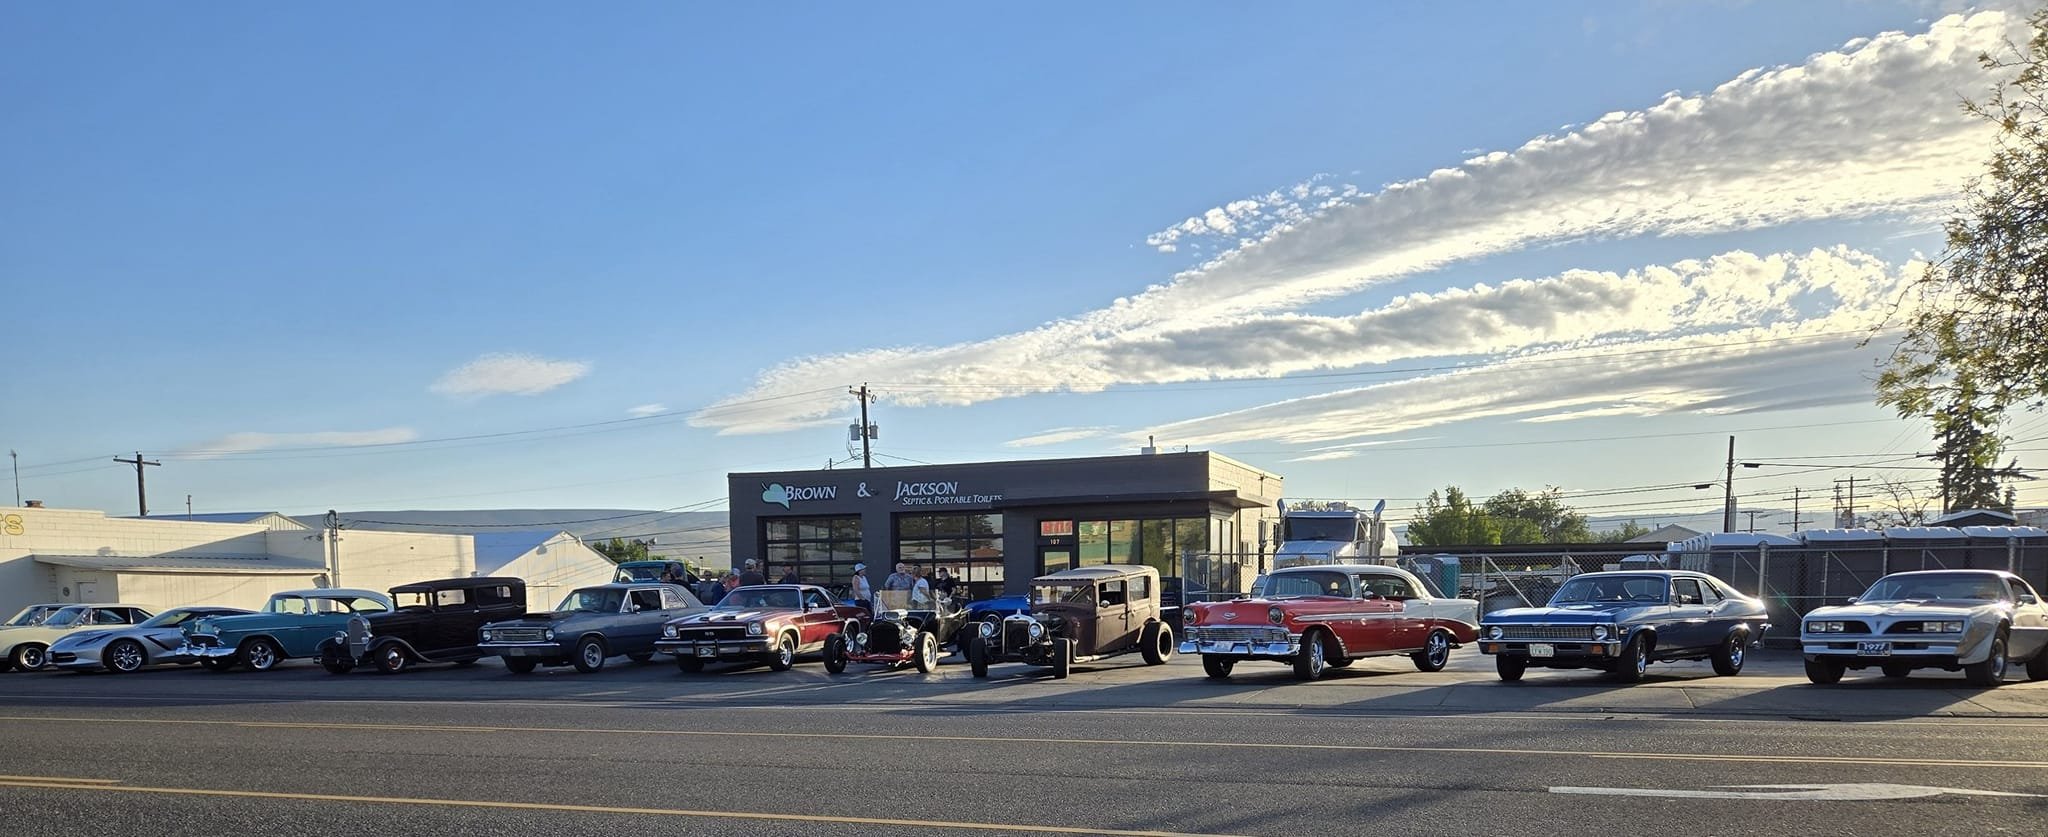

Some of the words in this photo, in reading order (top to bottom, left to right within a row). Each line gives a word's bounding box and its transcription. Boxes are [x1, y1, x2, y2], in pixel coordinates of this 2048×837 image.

[785, 485, 836, 500] BROWN
[857, 482, 872, 497] &
[893, 481, 958, 501] JACKSON
[902, 496, 926, 506] SEPTIC
[926, 497, 933, 505] &
[934, 495, 972, 505] PORTABLE
[1864, 642, 1886, 650] 1977
